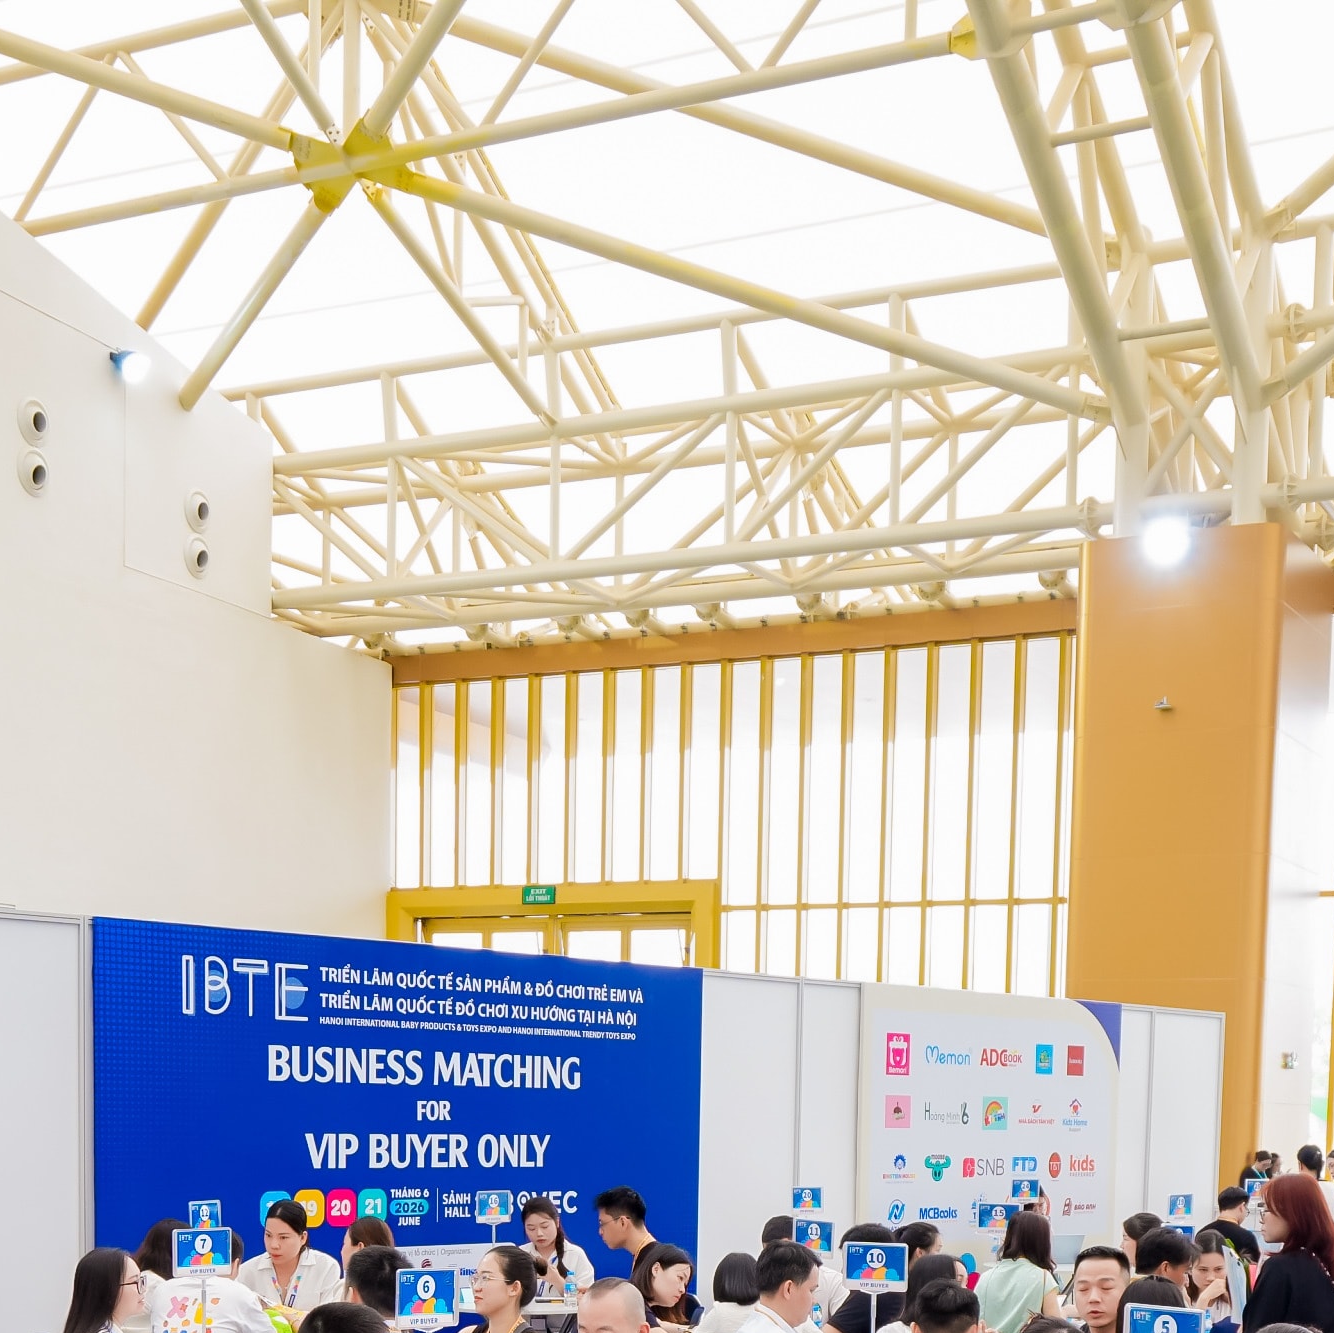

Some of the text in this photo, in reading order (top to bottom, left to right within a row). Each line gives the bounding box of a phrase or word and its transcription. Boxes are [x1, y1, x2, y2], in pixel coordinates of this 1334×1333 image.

[181, 954, 310, 1022] IBTE
[319, 964, 644, 1004] TRIỂN LÃM QUỐC TẾ SẢN PHẨM & ĐỒ CHƠI TRẺ EM VÀ
[319, 990, 361, 1011] TRIỂN
[363, 994, 393, 1012] LÃM
[396, 996, 436, 1016] QUỐC
[438, 997, 453, 1016] TẾ
[477, 1002, 509, 1020] CHƠI
[511, 1005, 529, 1020] XU
[531, 1004, 575, 1023] HƯỚNG
[577, 1009, 595, 1027] TẠI
[597, 1008, 615, 1026] HÀ
[617, 1009, 637, 1030] NỘI
[319, 1016, 637, 1042] HANOI INTERNATIONAL BABY PRODUCTS & TOYS EXPO AND HANOI INTERNATIONAL TRENDY TOYS EXPO
[267, 1044, 582, 1091] BUSINESS MATCHING
[416, 1100, 452, 1122] FOR
[305, 1132, 551, 1170] VIP BUYER ONLY
[977, 1158, 1005, 1176] SNB
[1011, 1156, 1038, 1172] FTD
[1069, 1154, 1095, 1172] kids
[389, 1186, 429, 1198] THÁNG 6
[442, 1188, 471, 1205] SẢNH
[331, 1200, 351, 1216] 20
[365, 1198, 383, 1214] 21
[395, 1202, 425, 1214] 2026
[445, 1206, 471, 1218] HALL
[919, 1206, 959, 1220] MCBooks
[397, 1216, 421, 1226] JUNE
[809, 1228, 819, 1236] 11
[199, 1238, 207, 1249] 7
[868, 1253, 884, 1264] 10
[423, 1280, 430, 1292] 6
